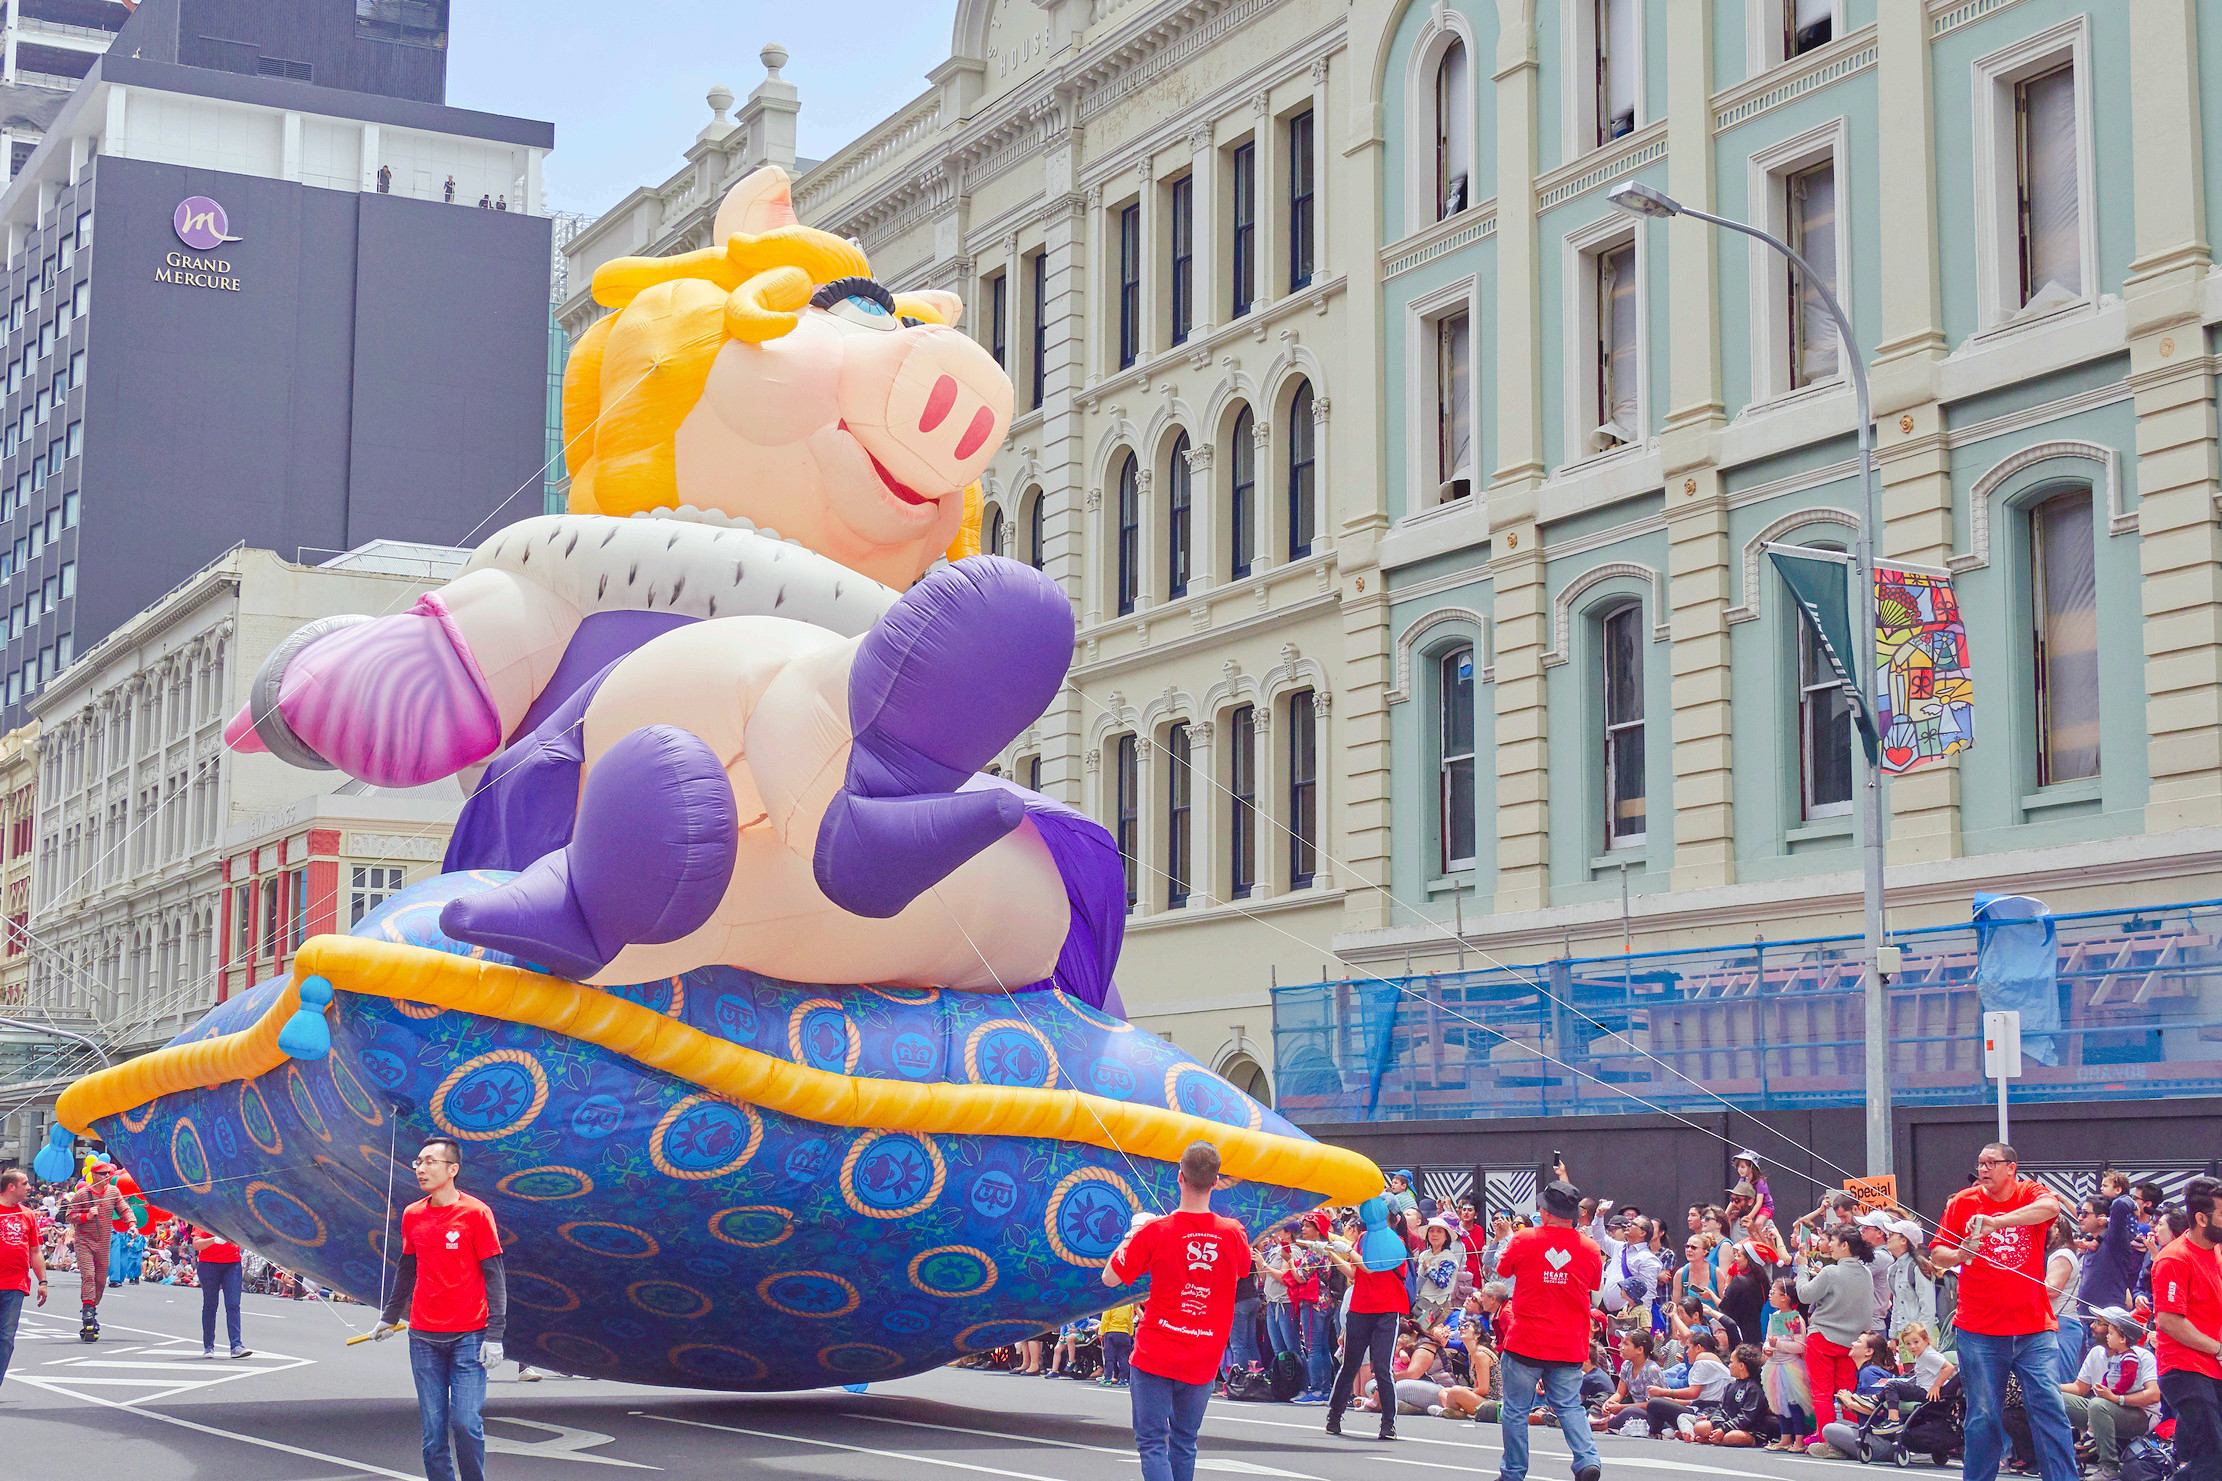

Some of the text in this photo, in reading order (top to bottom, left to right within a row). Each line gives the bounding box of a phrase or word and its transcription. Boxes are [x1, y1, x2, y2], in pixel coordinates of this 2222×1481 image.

[166, 252, 231, 273] GRAND
[155, 267, 240, 292] MERCURE
[2077, 1064, 2146, 1081] ORANGE
[1849, 1181, 1891, 1201] Special
[1990, 1227, 2019, 1244] 85
[1186, 1240, 1219, 1262] 85
